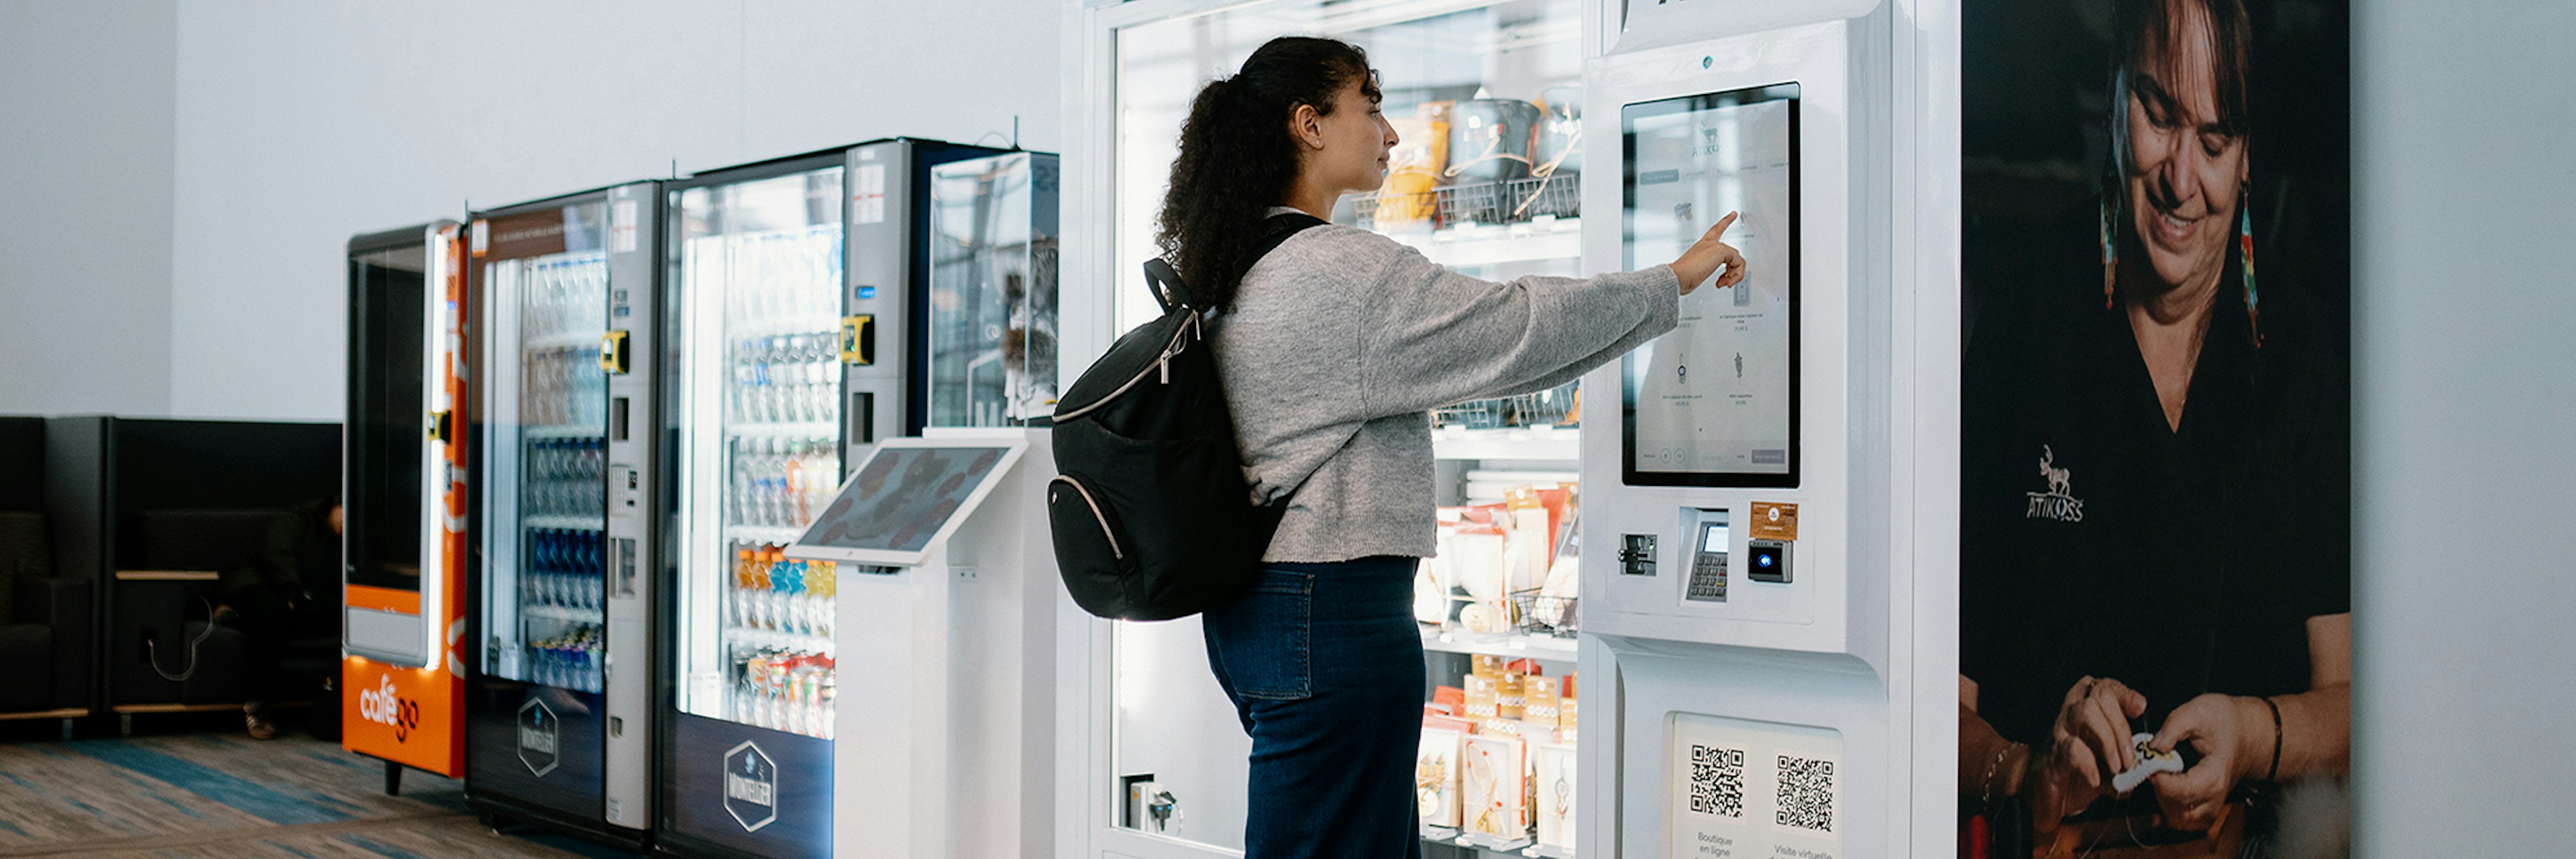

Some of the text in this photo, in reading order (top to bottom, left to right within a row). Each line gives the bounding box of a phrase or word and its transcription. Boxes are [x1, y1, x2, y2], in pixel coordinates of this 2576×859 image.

[2027, 496, 2084, 522] ATIKOSS
[1698, 831, 1733, 846] Boutique
[1699, 845, 1730, 858] en ligne
[1774, 844, 1796, 856] Visite
